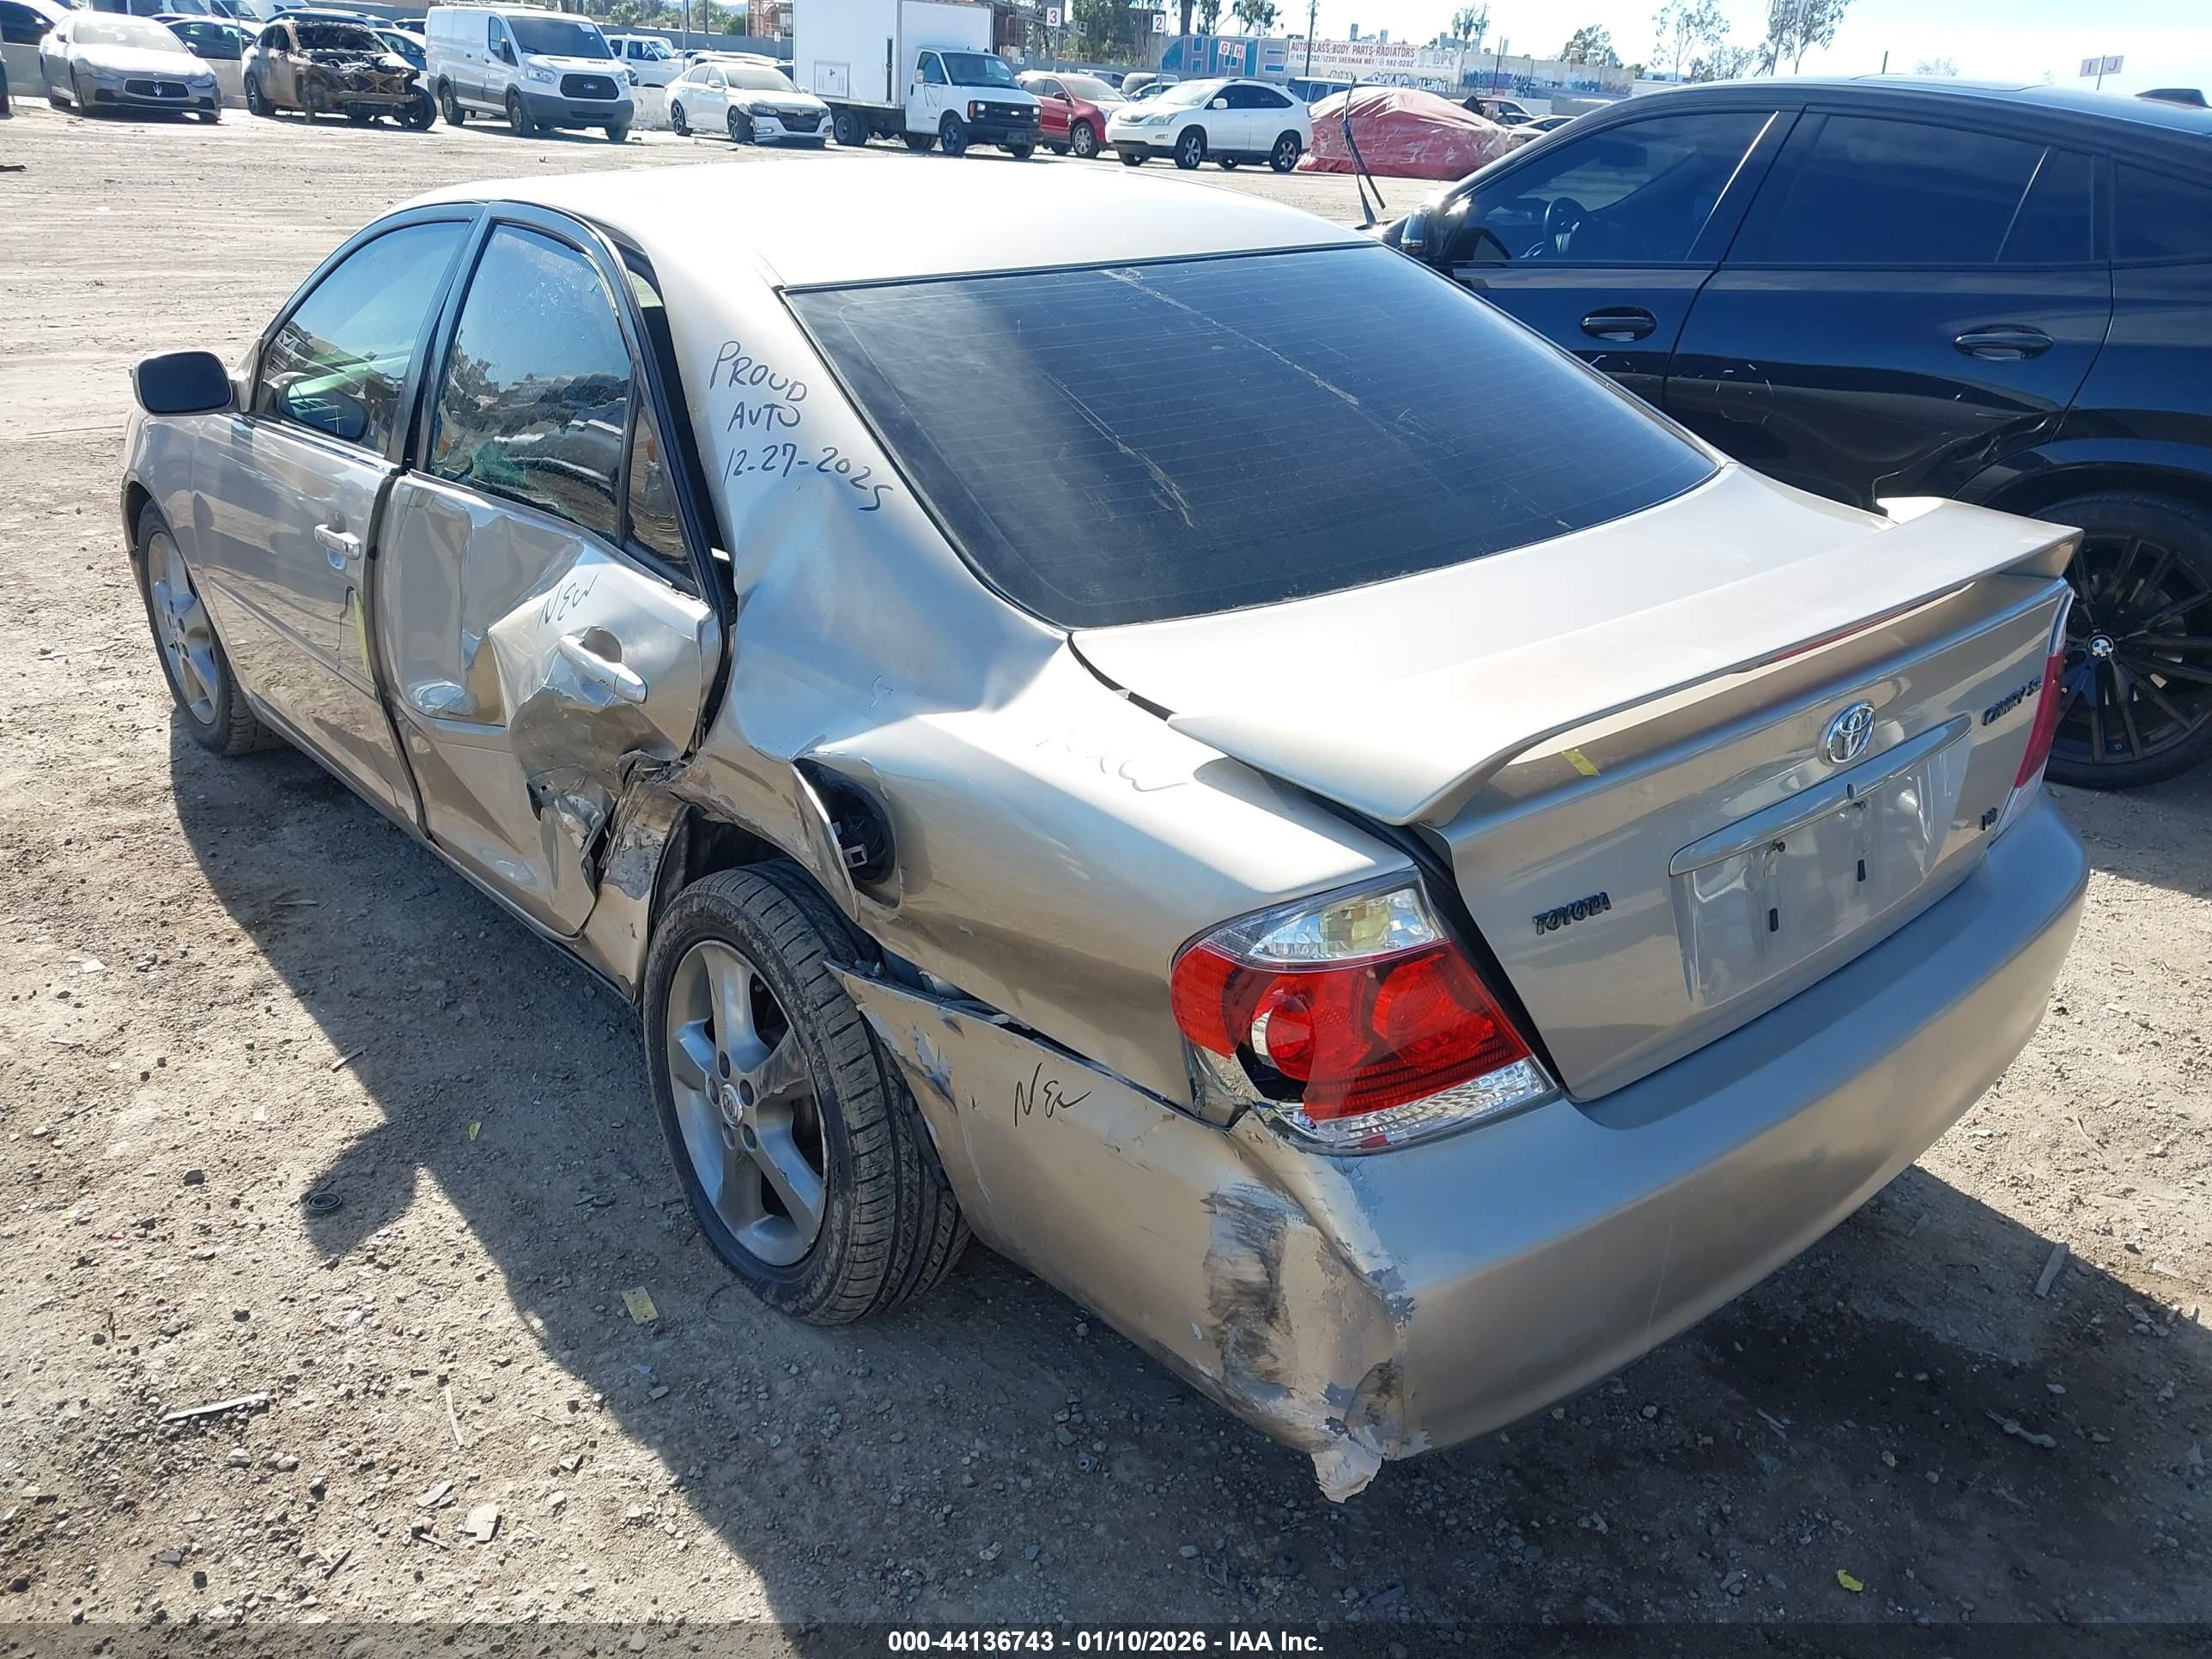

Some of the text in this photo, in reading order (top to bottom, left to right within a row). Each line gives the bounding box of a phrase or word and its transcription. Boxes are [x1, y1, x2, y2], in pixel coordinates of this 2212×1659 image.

[1049, 9, 1058, 24] 3
[1155, 16, 1163, 30] 2
[1256, 24, 1261, 34] 1
[1221, 43, 1228, 53] G
[1236, 46, 1244, 57] H
[1291, 41, 1308, 52] AUTO
[2108, 58, 2118, 71] J
[709, 340, 808, 402] PROUD
[722, 442, 894, 512] 12-27-2025
[1532, 891, 1613, 936] TOYOTA
